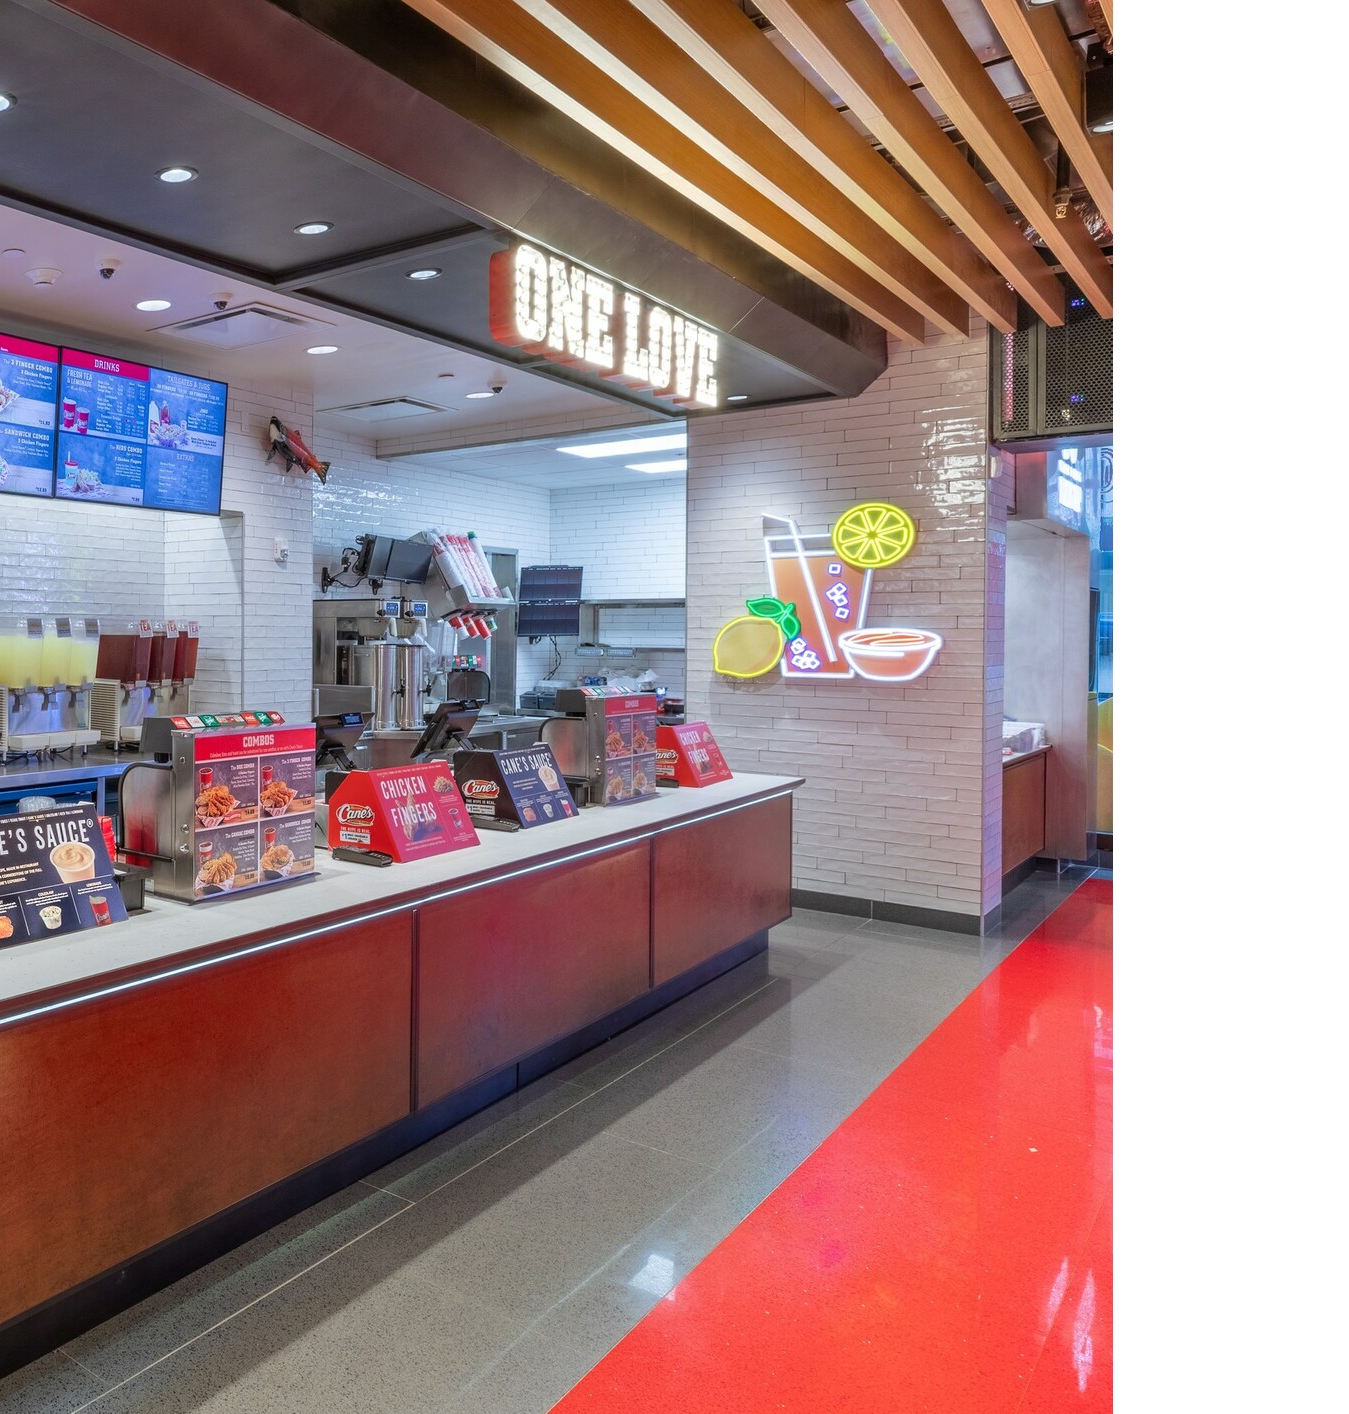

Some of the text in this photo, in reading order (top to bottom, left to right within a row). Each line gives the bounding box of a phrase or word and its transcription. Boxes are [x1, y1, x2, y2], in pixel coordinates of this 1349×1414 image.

[515, 244, 718, 407] ONE LOVE
[15, 360, 34, 369] FINGER
[36, 364, 53, 373] COMBO
[94, 359, 120, 372] DRINKS
[67, 369, 92, 381] FRESH TEA
[71, 378, 92, 388] LEMONADE
[5, 428, 31, 438] SANDWICH
[33, 432, 49, 441] COMBO
[116, 444, 126, 452] KIDS
[128, 446, 142, 454] COMBO
[176, 453, 194, 462] EXTRAS
[140, 623, 151, 631] TEA
[167, 623, 177, 632] TEA
[243, 734, 275, 748] COMBOS
[679, 731, 701, 746] CHICKEN
[688, 748, 709, 763] FINGERS
[501, 756, 529, 775] CANE'S
[380, 776, 427, 800] CHICKEN
[465, 780, 497, 797] Cane's
[339, 804, 372, 822] Cane's
[391, 802, 437, 827] FINGERS
